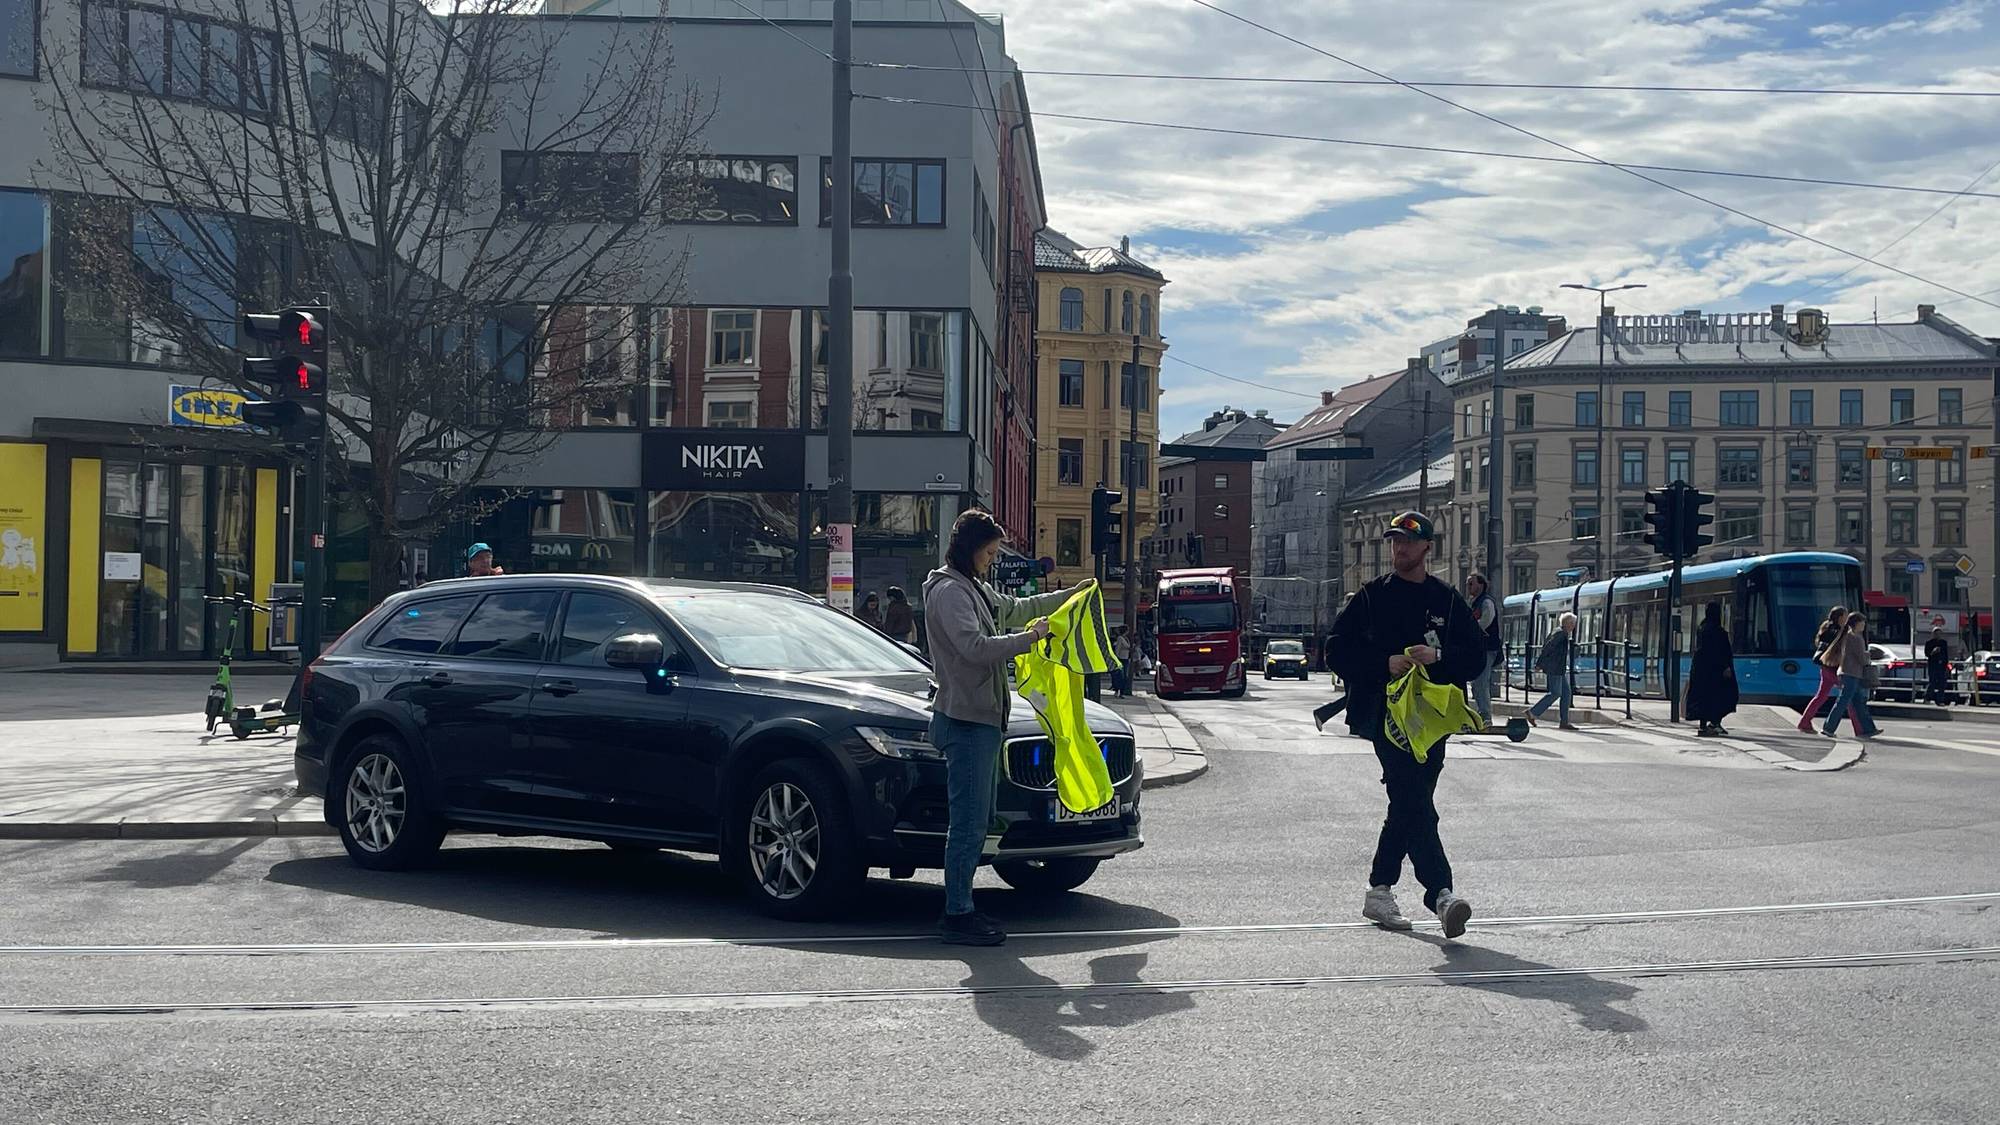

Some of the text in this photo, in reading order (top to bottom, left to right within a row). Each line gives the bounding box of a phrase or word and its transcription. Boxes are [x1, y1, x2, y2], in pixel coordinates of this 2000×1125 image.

[1708, 312, 1770, 344] KAFFE
[682, 445, 764, 468] NIKITA
[1001, 561, 1028, 569] FALAFEL
